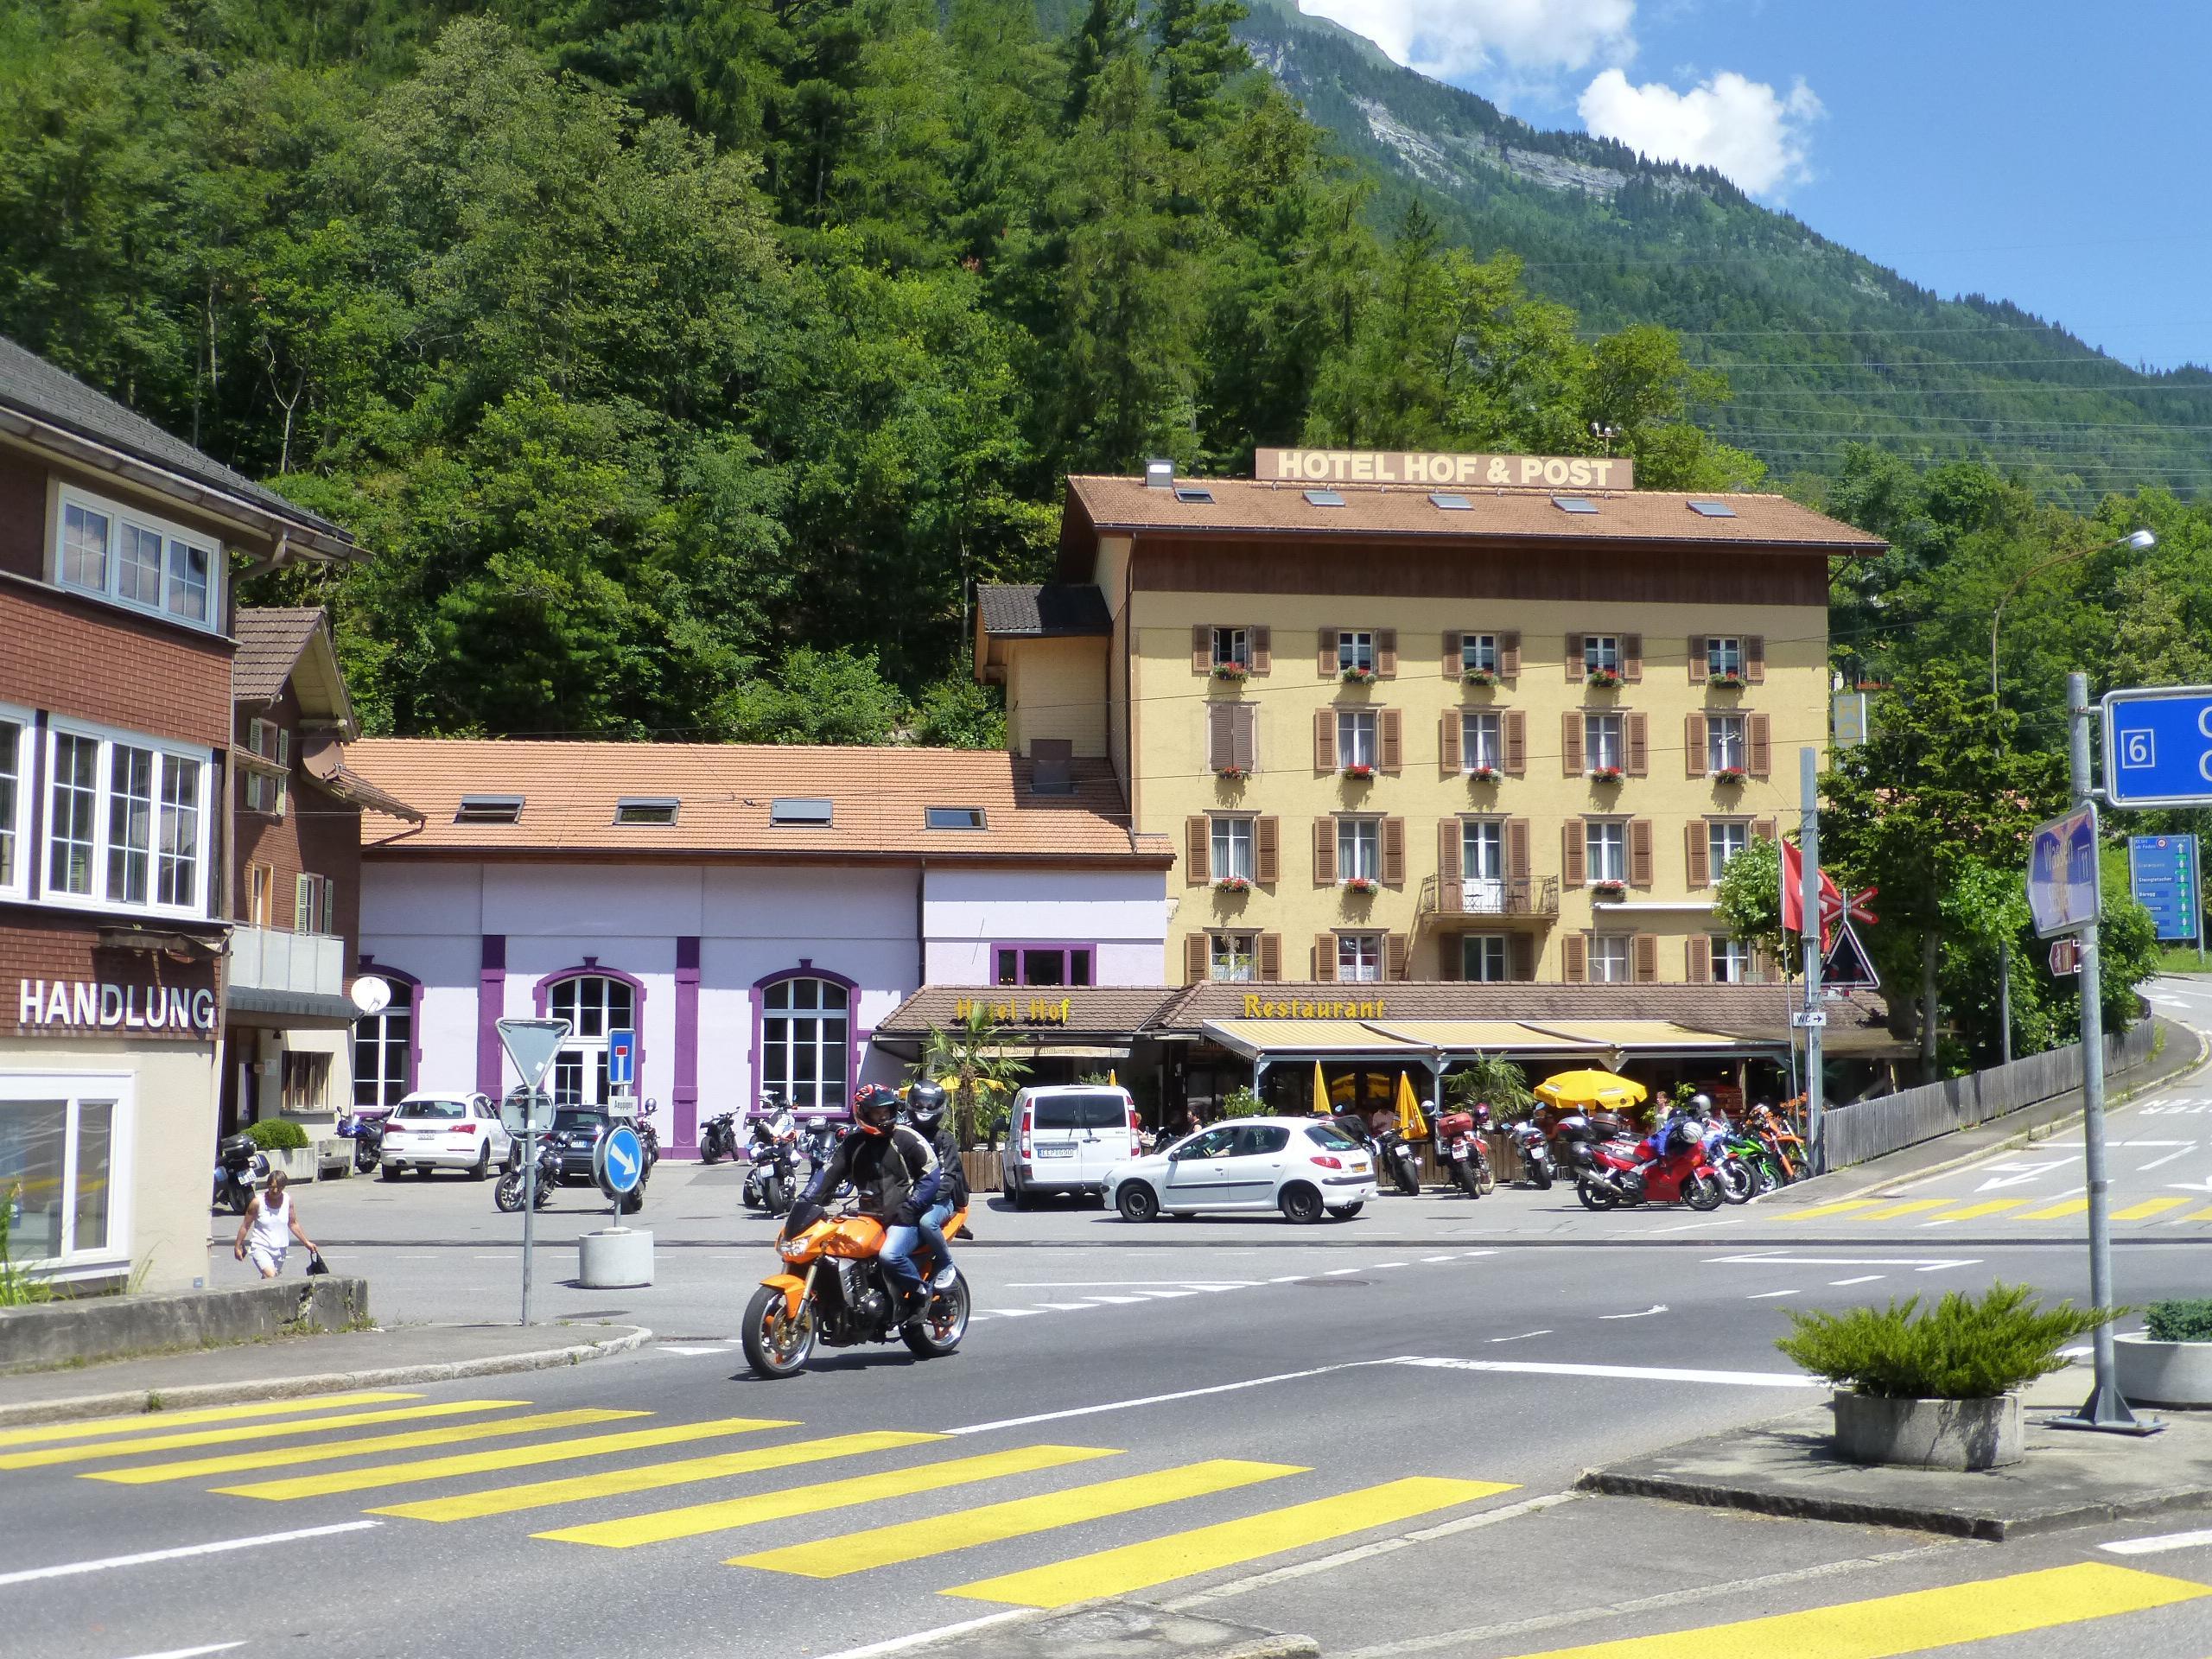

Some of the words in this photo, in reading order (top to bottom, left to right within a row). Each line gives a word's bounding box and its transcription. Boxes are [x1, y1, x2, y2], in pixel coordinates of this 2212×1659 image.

[1278, 452, 1395, 480] HOTEL
[1405, 454, 1478, 482] HOF
[1487, 457, 1510, 484] &
[1522, 459, 1611, 486] POST
[2129, 735, 2146, 762] 6
[20, 979, 214, 1029] HANDLUNG
[1029, 997, 1071, 1023] Hof
[1243, 994, 1384, 1018] Restaurant
[1796, 1014, 1811, 1023] WC
